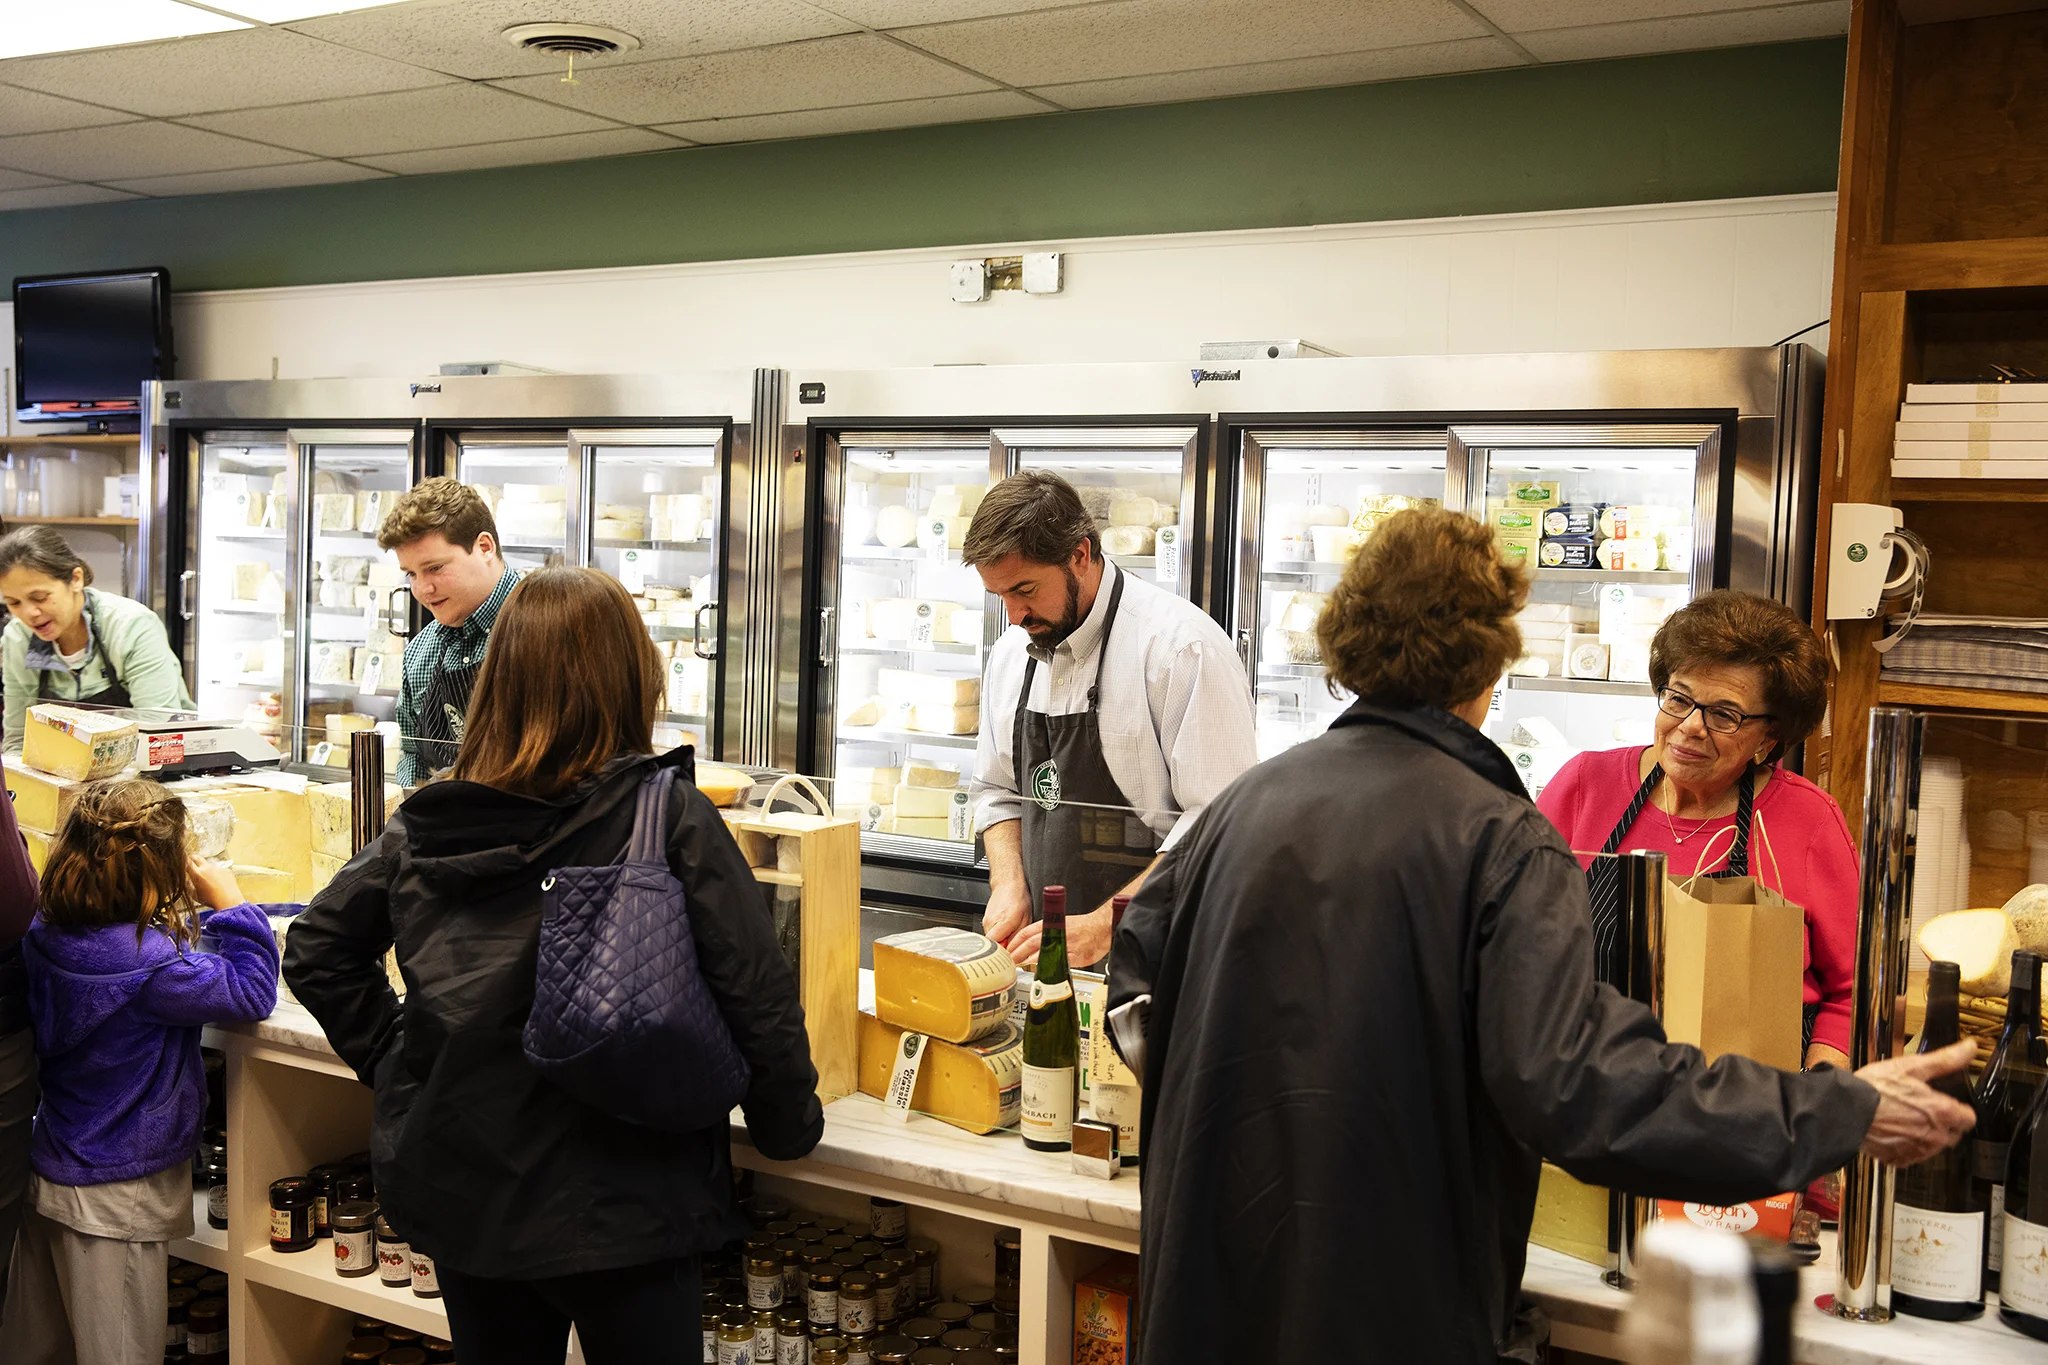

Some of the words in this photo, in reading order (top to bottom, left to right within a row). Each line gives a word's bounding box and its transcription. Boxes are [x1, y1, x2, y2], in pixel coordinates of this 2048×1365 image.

[896, 1069, 910, 1106] Classic
[1765, 1200, 1789, 1210] MIDGET
[1704, 1219, 1741, 1232] WRAP
[1899, 1217, 1954, 1233] SANCERRE
[1088, 1321, 1118, 1337] Perruche
